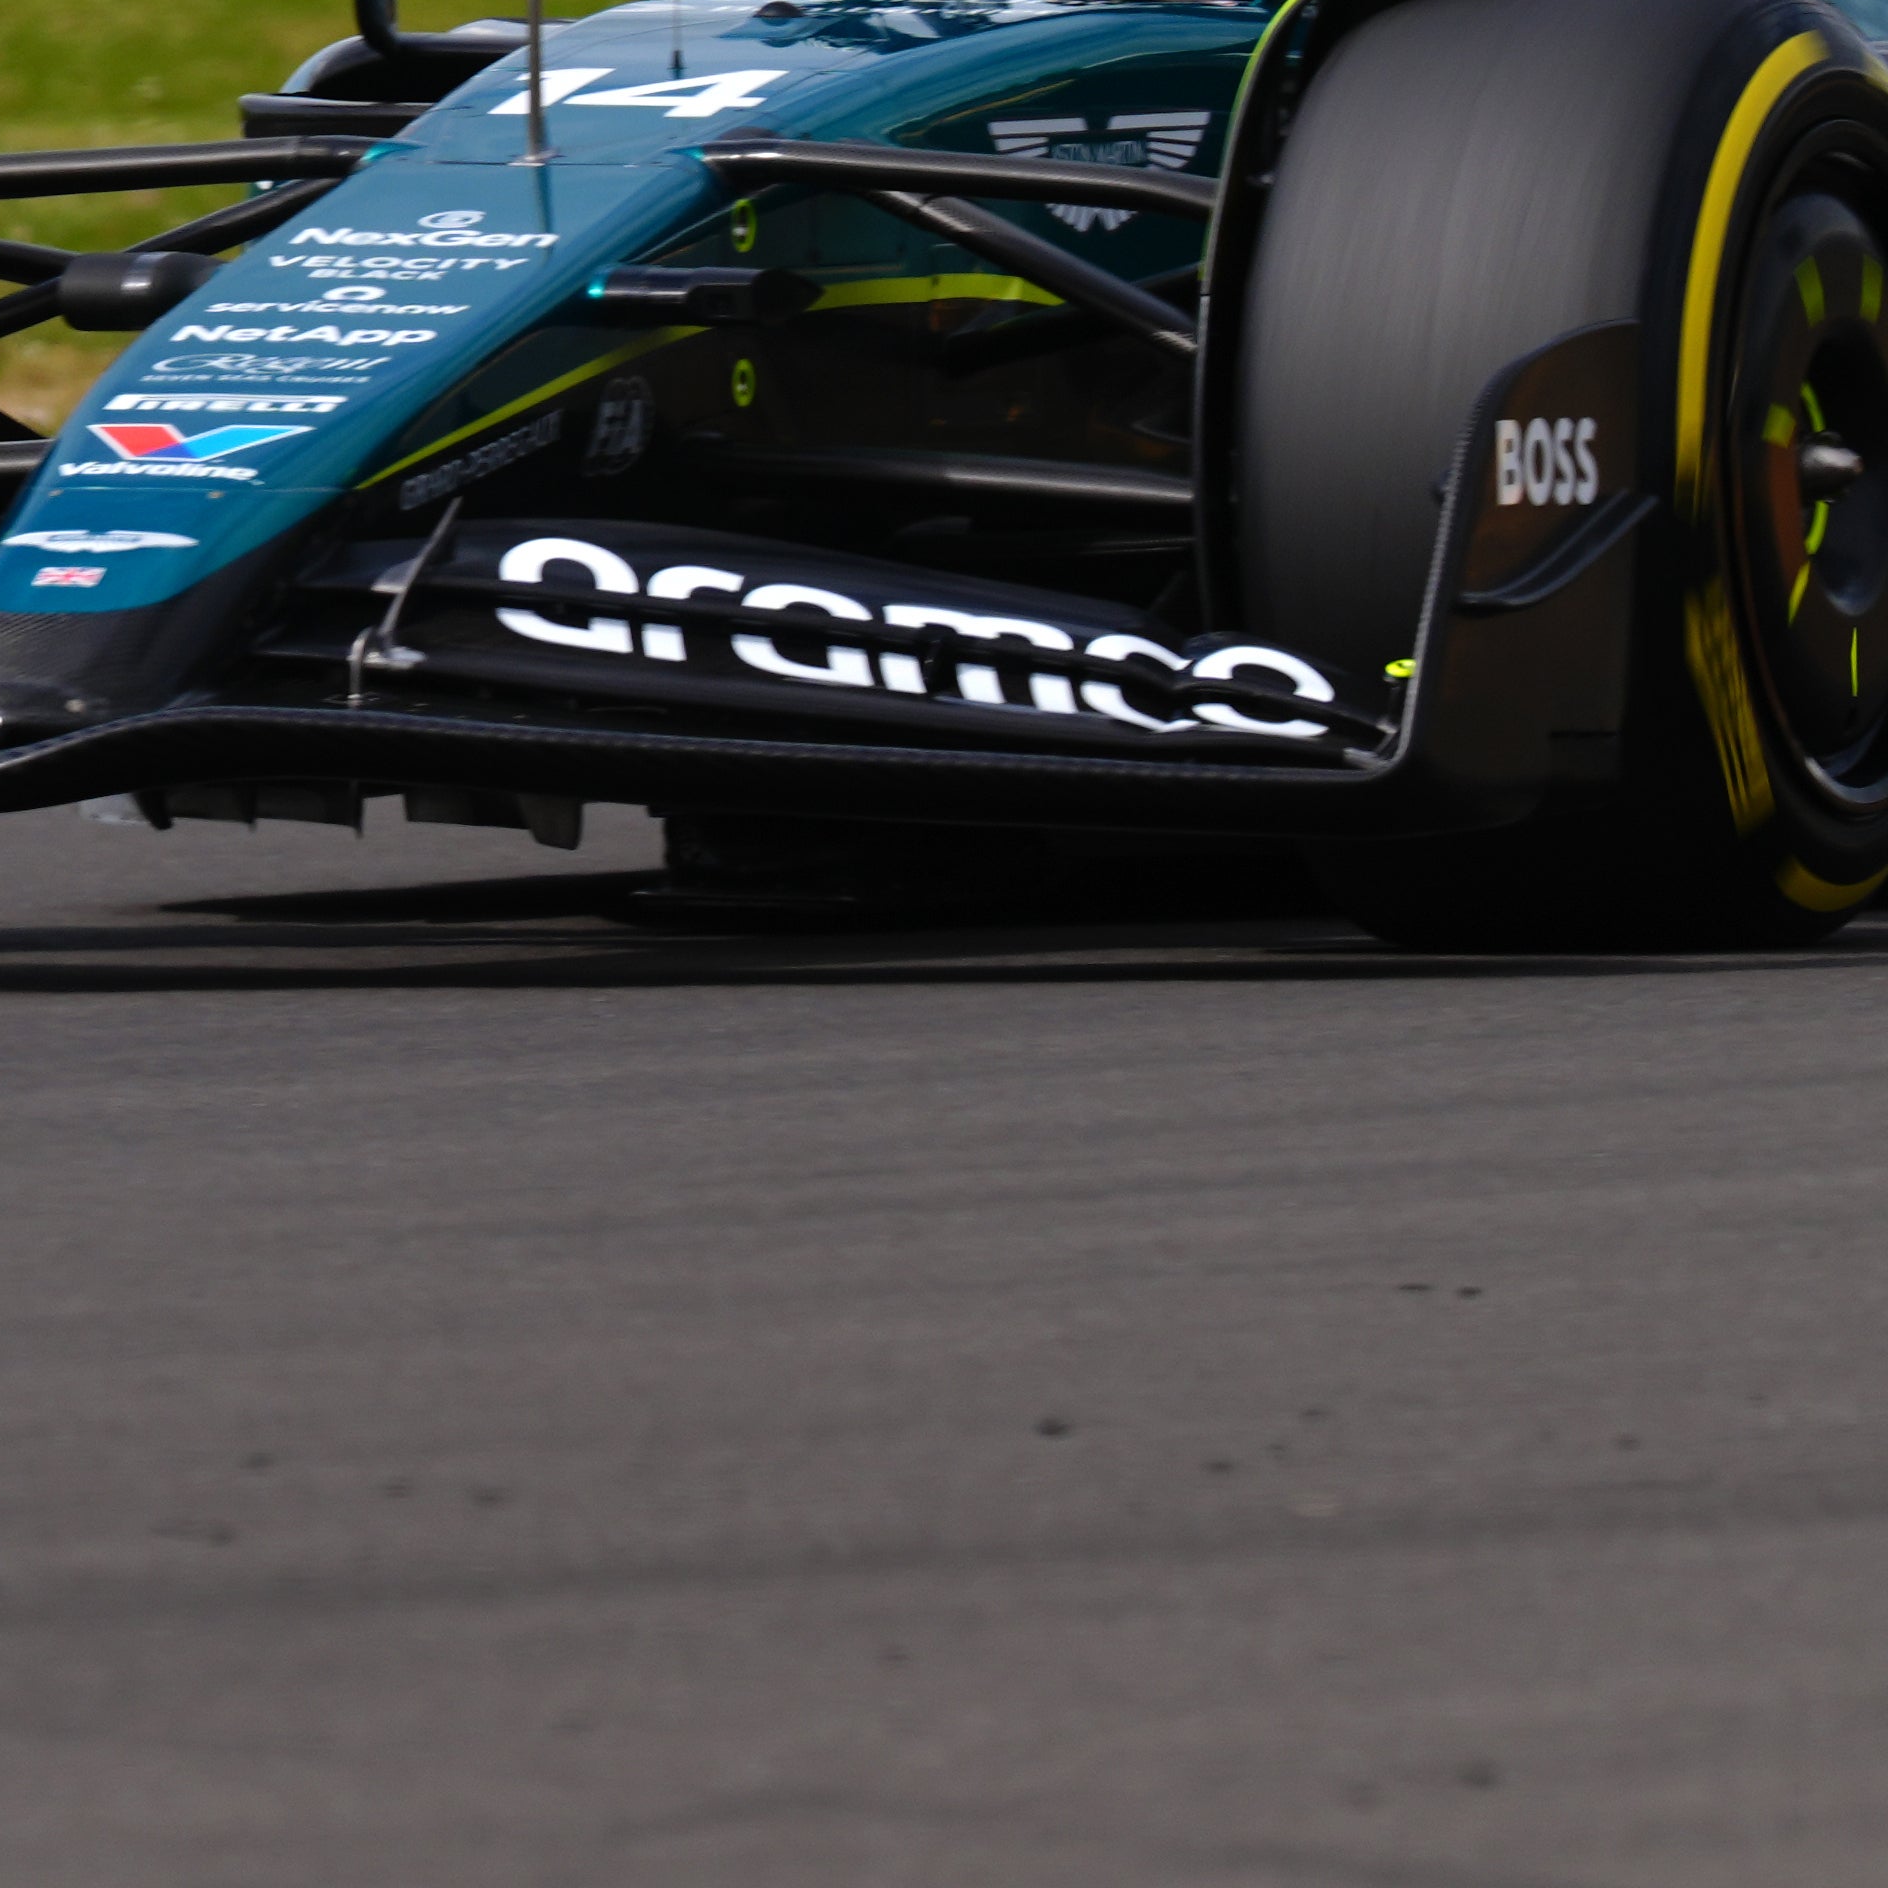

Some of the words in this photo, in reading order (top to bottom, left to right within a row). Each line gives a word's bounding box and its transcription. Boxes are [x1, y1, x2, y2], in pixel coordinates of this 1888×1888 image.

[489, 68, 790, 118] 14
[289, 227, 559, 248] NexGen
[268, 255, 531, 270] VELOCITY
[307, 268, 447, 281] BLACK
[205, 299, 471, 314] servicenow
[170, 324, 438, 347] NetApp
[103, 393, 349, 413] PIRELLI
[58, 461, 259, 481] Valvoline
[1495, 417, 1599, 506] BOSS
[498, 537, 1337, 739] aramco
